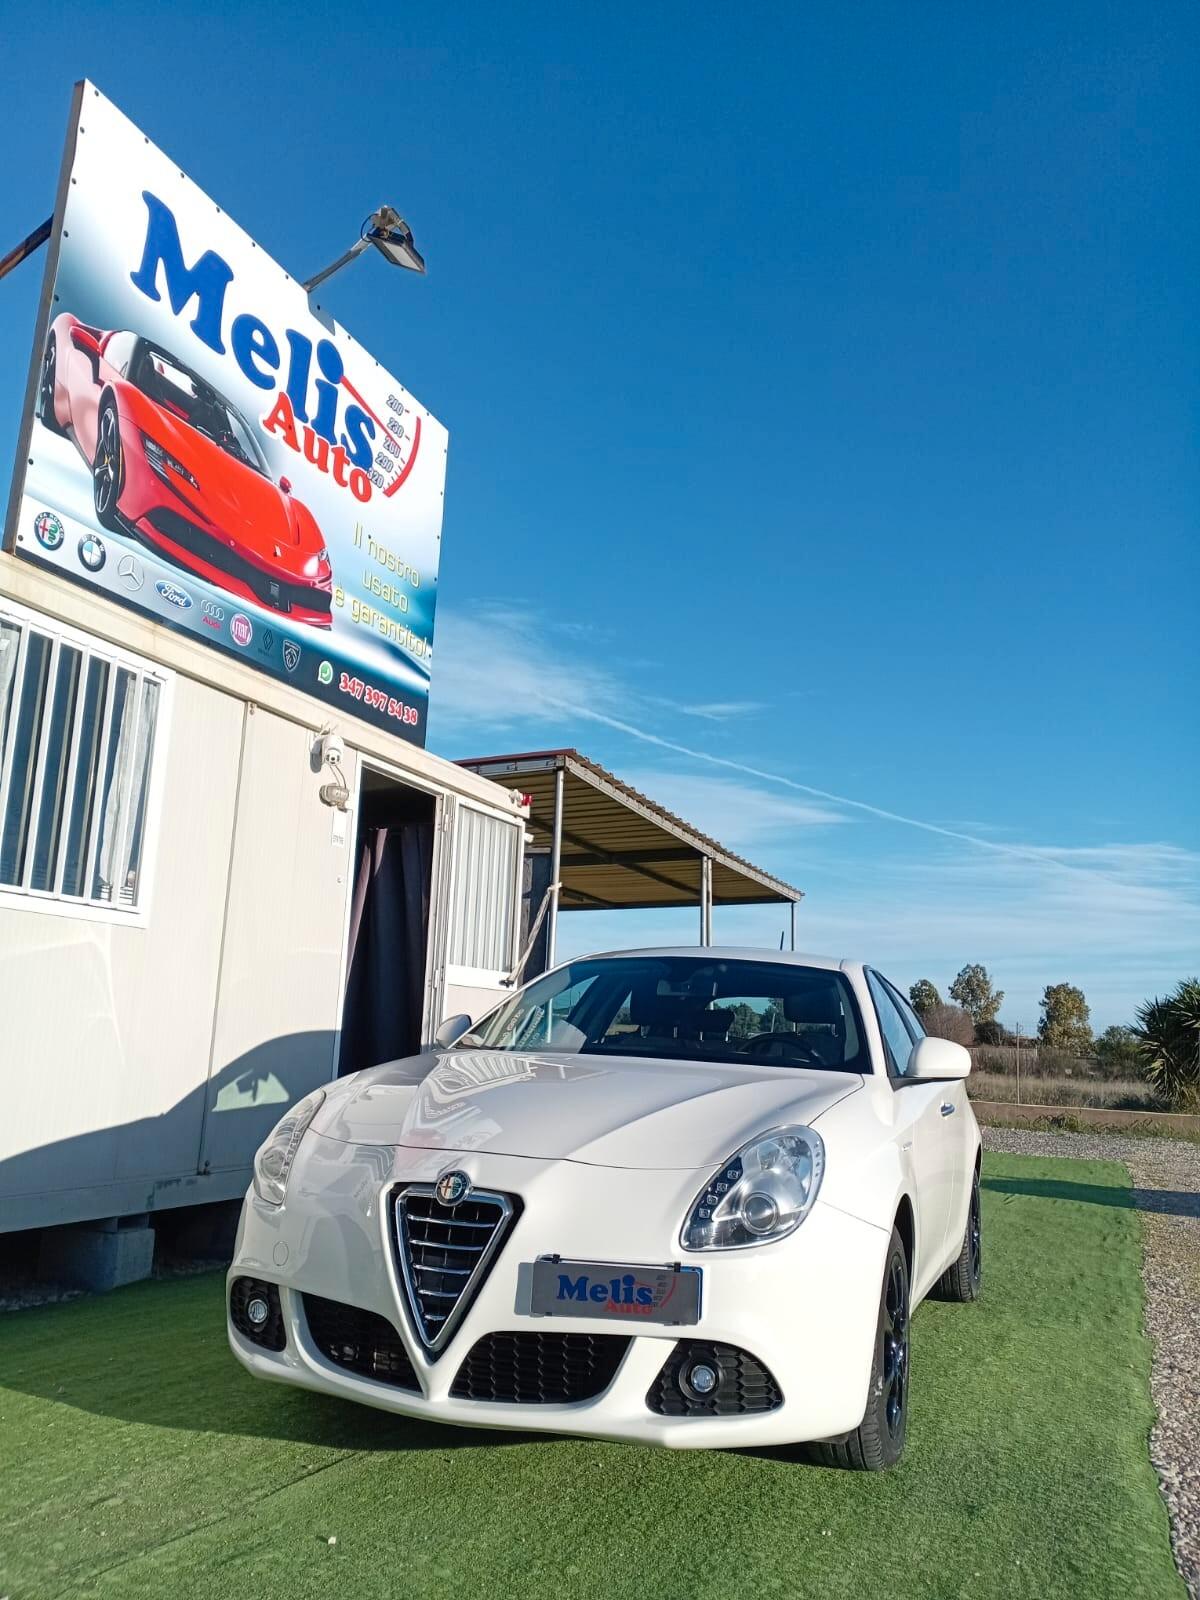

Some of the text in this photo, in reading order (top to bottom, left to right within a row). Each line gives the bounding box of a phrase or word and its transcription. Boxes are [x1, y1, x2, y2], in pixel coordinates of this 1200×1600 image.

[130, 190, 376, 471] Melis
[386, 394, 404, 416] 200
[387, 417, 404, 438] 230
[262, 391, 372, 502] Auto
[375, 452, 394, 473] 290
[367, 468, 384, 488] 320
[353, 521, 419, 588] Il nostro
[161, 583, 187, 607] Ford
[362, 569, 409, 613] usato
[202, 615, 221, 630] Audi
[351, 599, 428, 660] garantito!
[339, 673, 418, 725] 347 397 54 38
[556, 1274, 653, 1306] Melis
[603, 1299, 653, 1316] Auto
